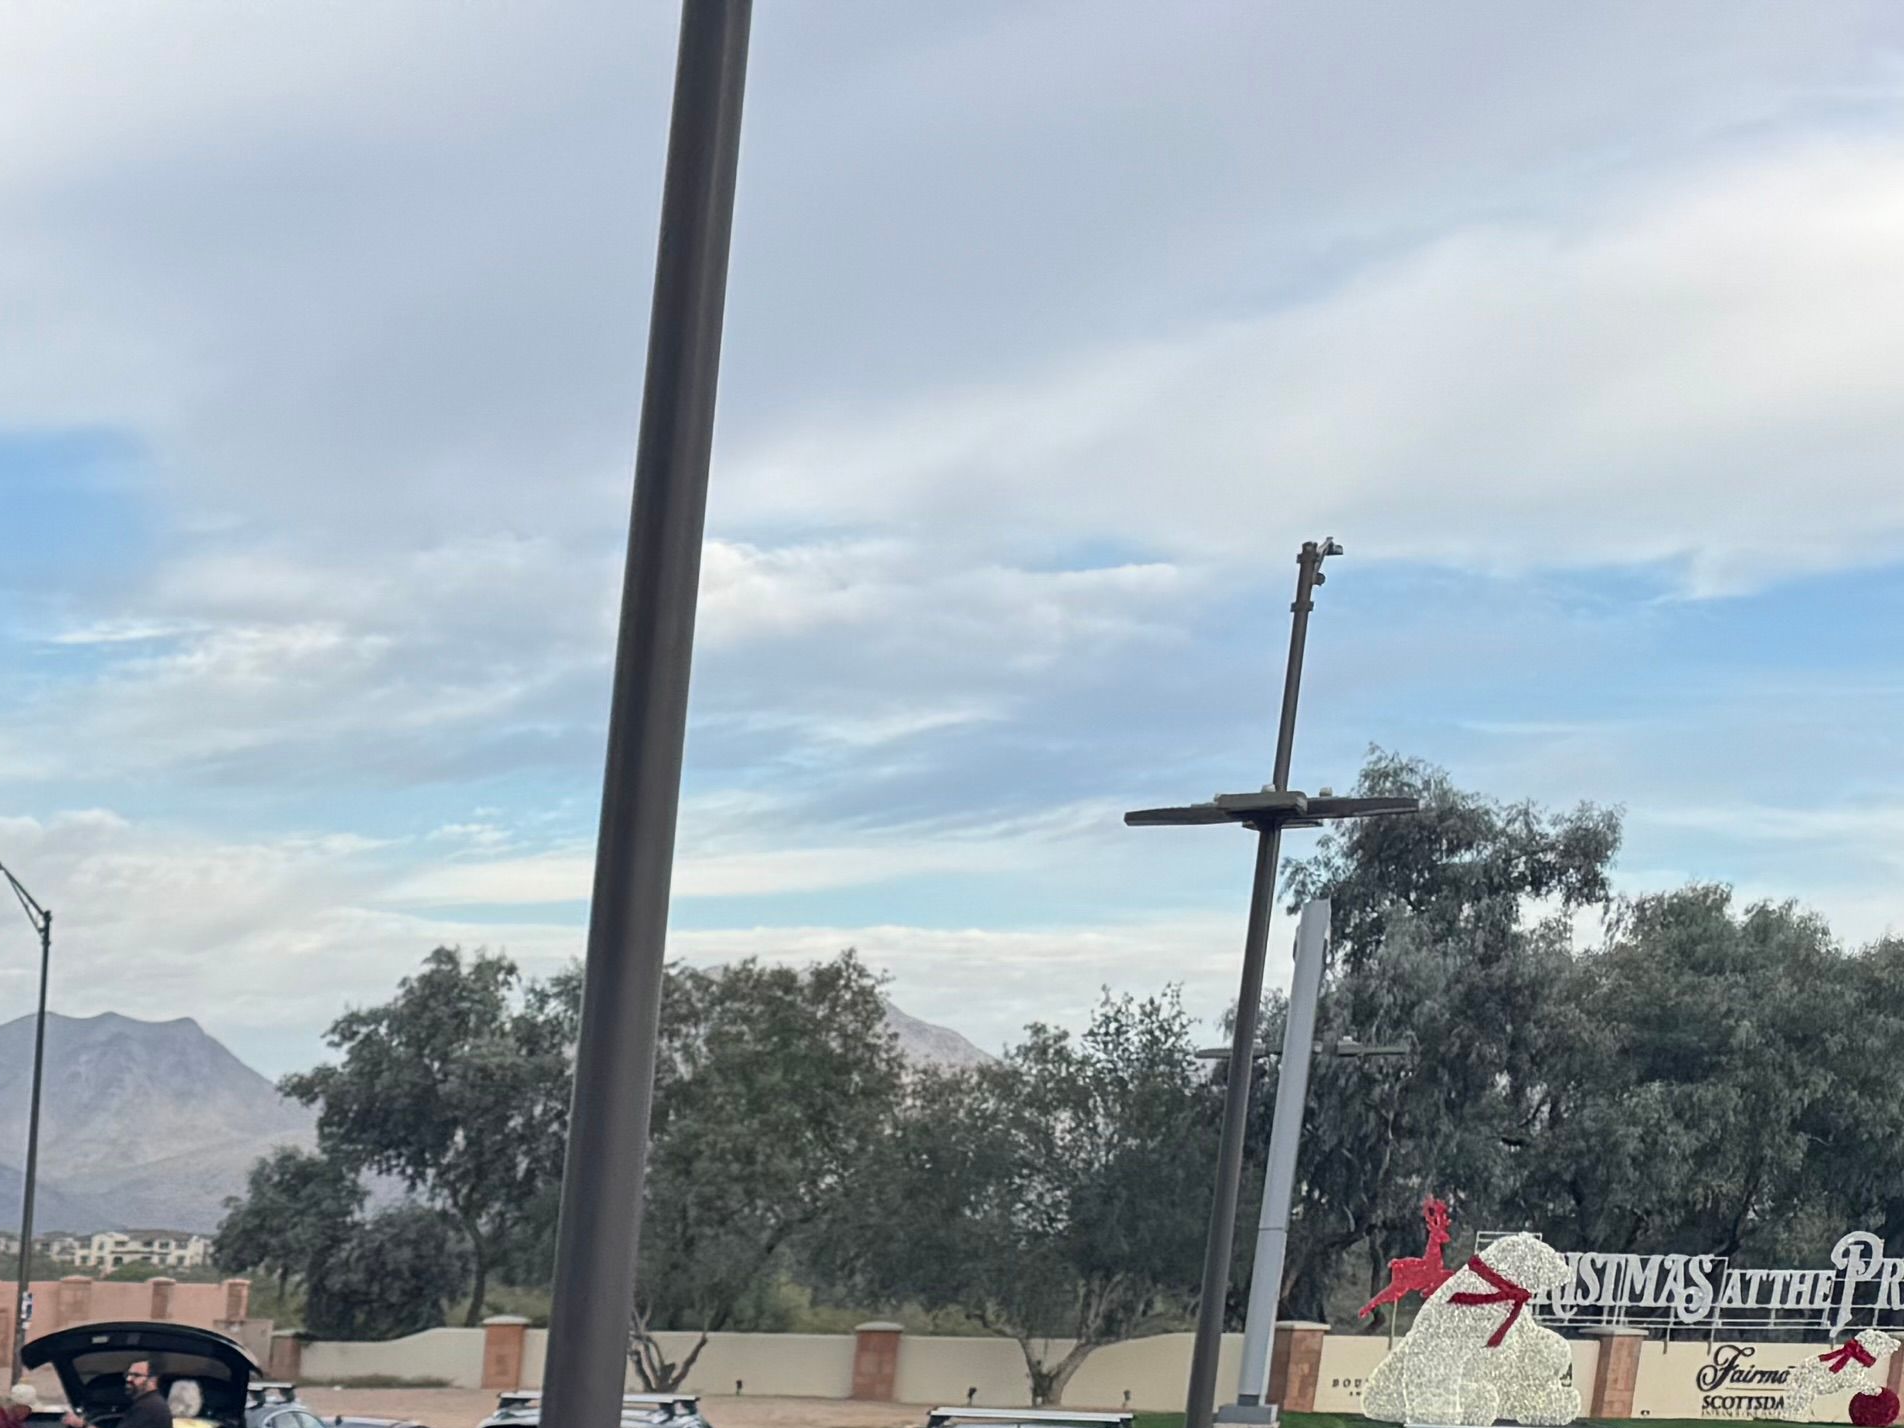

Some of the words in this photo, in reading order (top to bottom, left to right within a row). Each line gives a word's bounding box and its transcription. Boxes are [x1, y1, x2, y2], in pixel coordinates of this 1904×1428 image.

[1534, 1252, 1716, 1324] ISTMAS
[1829, 1230, 1904, 1338] PR
[1696, 1344, 1795, 1392] Fairmo
[1701, 1395, 1785, 1411] SCOTTSDA
